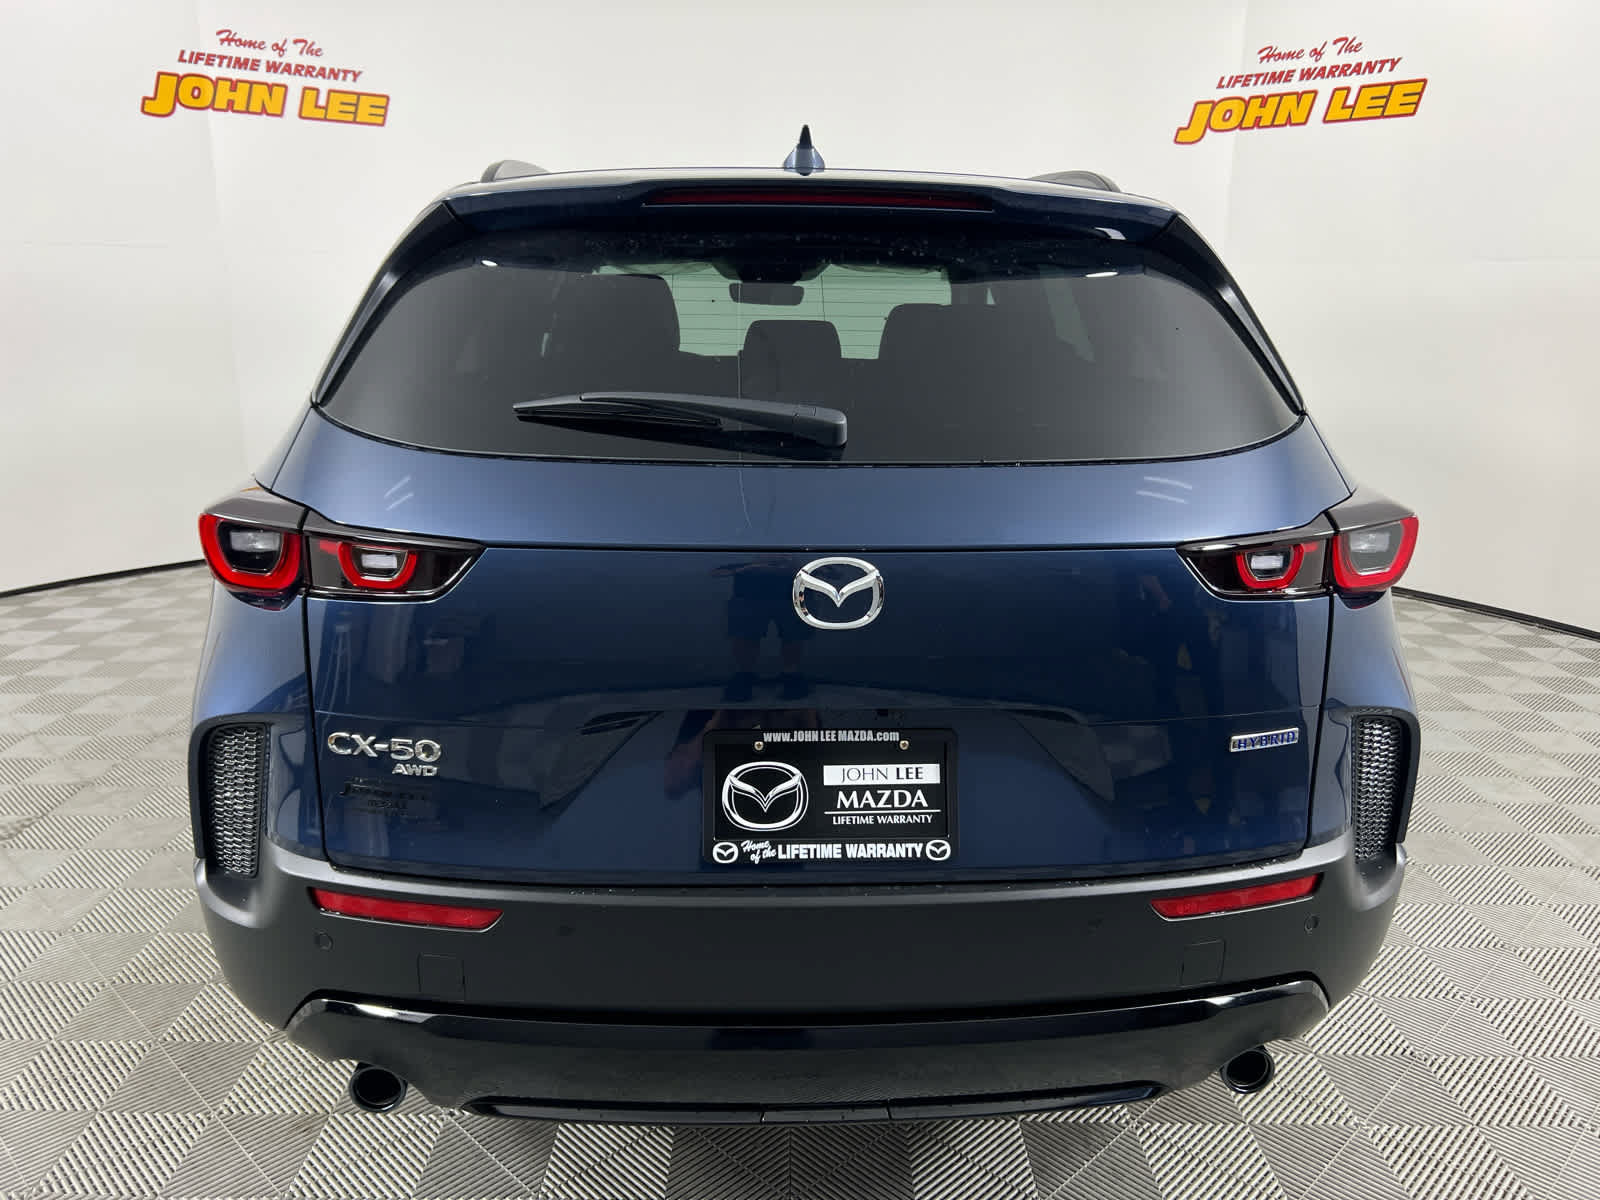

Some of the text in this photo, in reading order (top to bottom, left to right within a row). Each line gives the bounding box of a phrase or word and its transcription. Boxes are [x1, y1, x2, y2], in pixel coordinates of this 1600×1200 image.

[216, 29, 324, 58] Home of The
[1257, 37, 1363, 64] Home of The
[178, 49, 362, 82] LIFETIME WARRANTY
[1216, 57, 1402, 89] LIFETIME WARRANTY
[141, 71, 390, 127] JOHN LEE
[1173, 78, 1428, 144] JOHN LEE
[328, 732, 441, 762] CX-50
[1237, 731, 1296, 749] HYBRID
[391, 763, 438, 776] AWD
[841, 766, 924, 783] JOHN LEE
[836, 789, 928, 809] MAZDA
[833, 814, 933, 825] LIFETIME WARRANTY
[741, 840, 770, 850] Home
[778, 843, 923, 860] LIFETIME WARRANTY
[750, 847, 777, 864] of the
